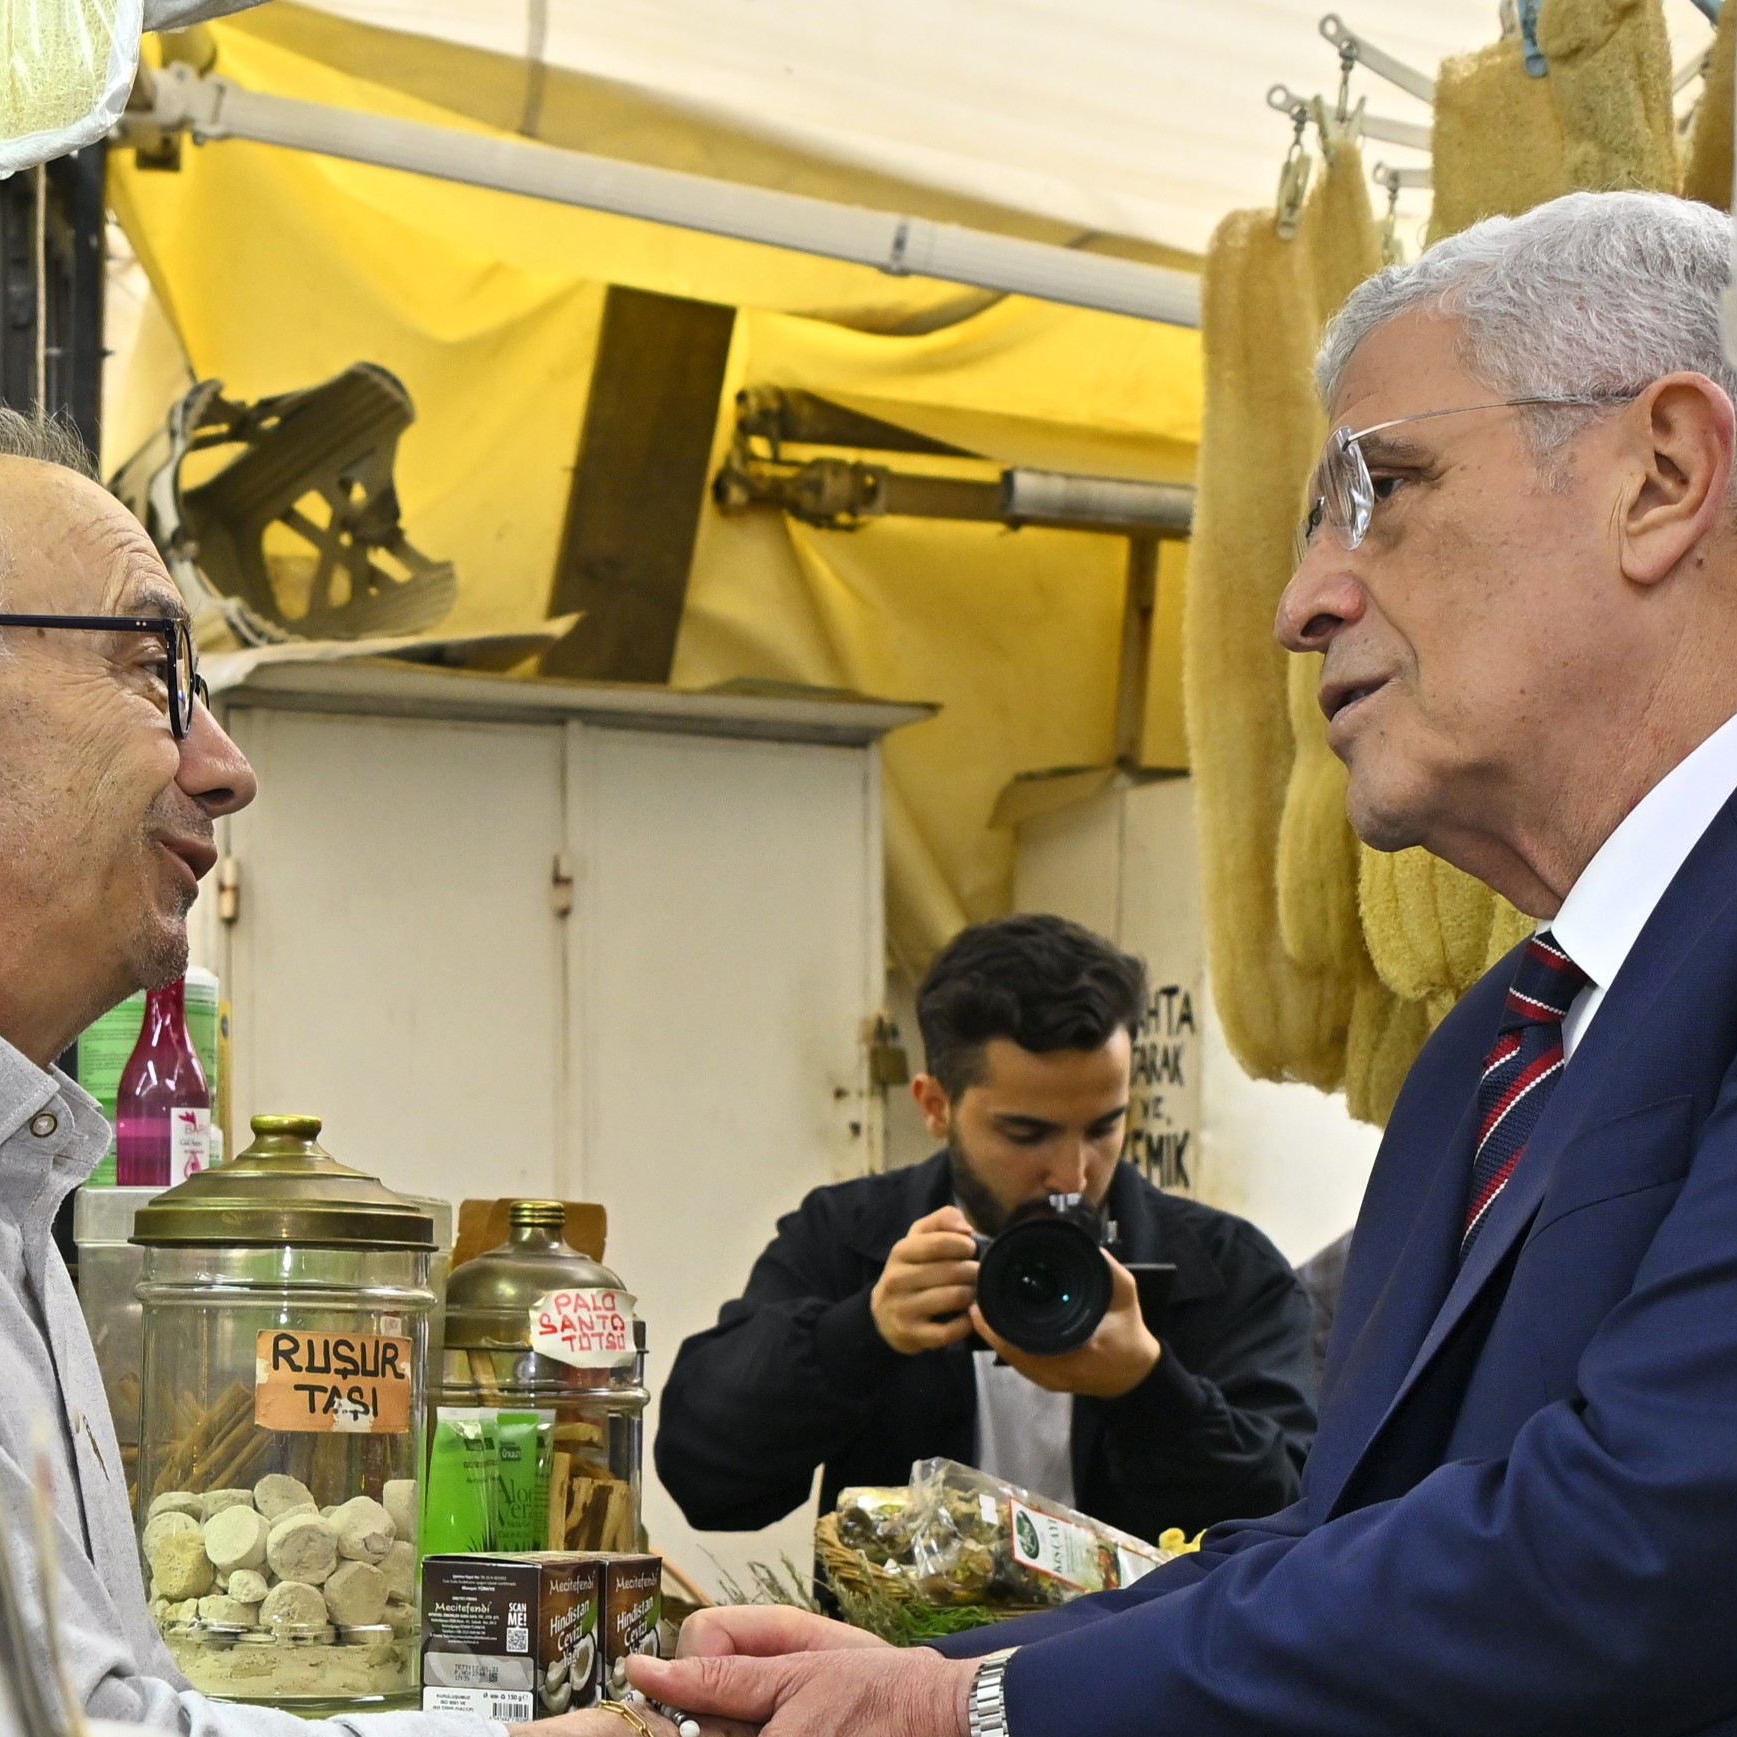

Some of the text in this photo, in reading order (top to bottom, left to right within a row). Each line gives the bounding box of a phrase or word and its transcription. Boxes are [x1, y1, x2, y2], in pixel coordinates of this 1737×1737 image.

[1138, 985, 1197, 1036] HTA
[554, 1291, 617, 1316] PALO
[538, 1312, 626, 1335] SANTO
[272, 1332, 406, 1380] RUŞUR
[293, 1384, 379, 1422] TAŞI
[549, 1574, 595, 1596] Mecitefendi
[615, 1572, 658, 1593] Mecitefendi
[434, 1602, 490, 1614] Mecitefendi
[507, 1612, 527, 1627] ME!
[508, 1602, 527, 1612] SCAN
[550, 1599, 590, 1638] Hindistan
[616, 1595, 654, 1633] Hindistan
[557, 1620, 583, 1652] Cevizi
[623, 1617, 648, 1648] Cevizi
[562, 1647, 580, 1669] Yağı
